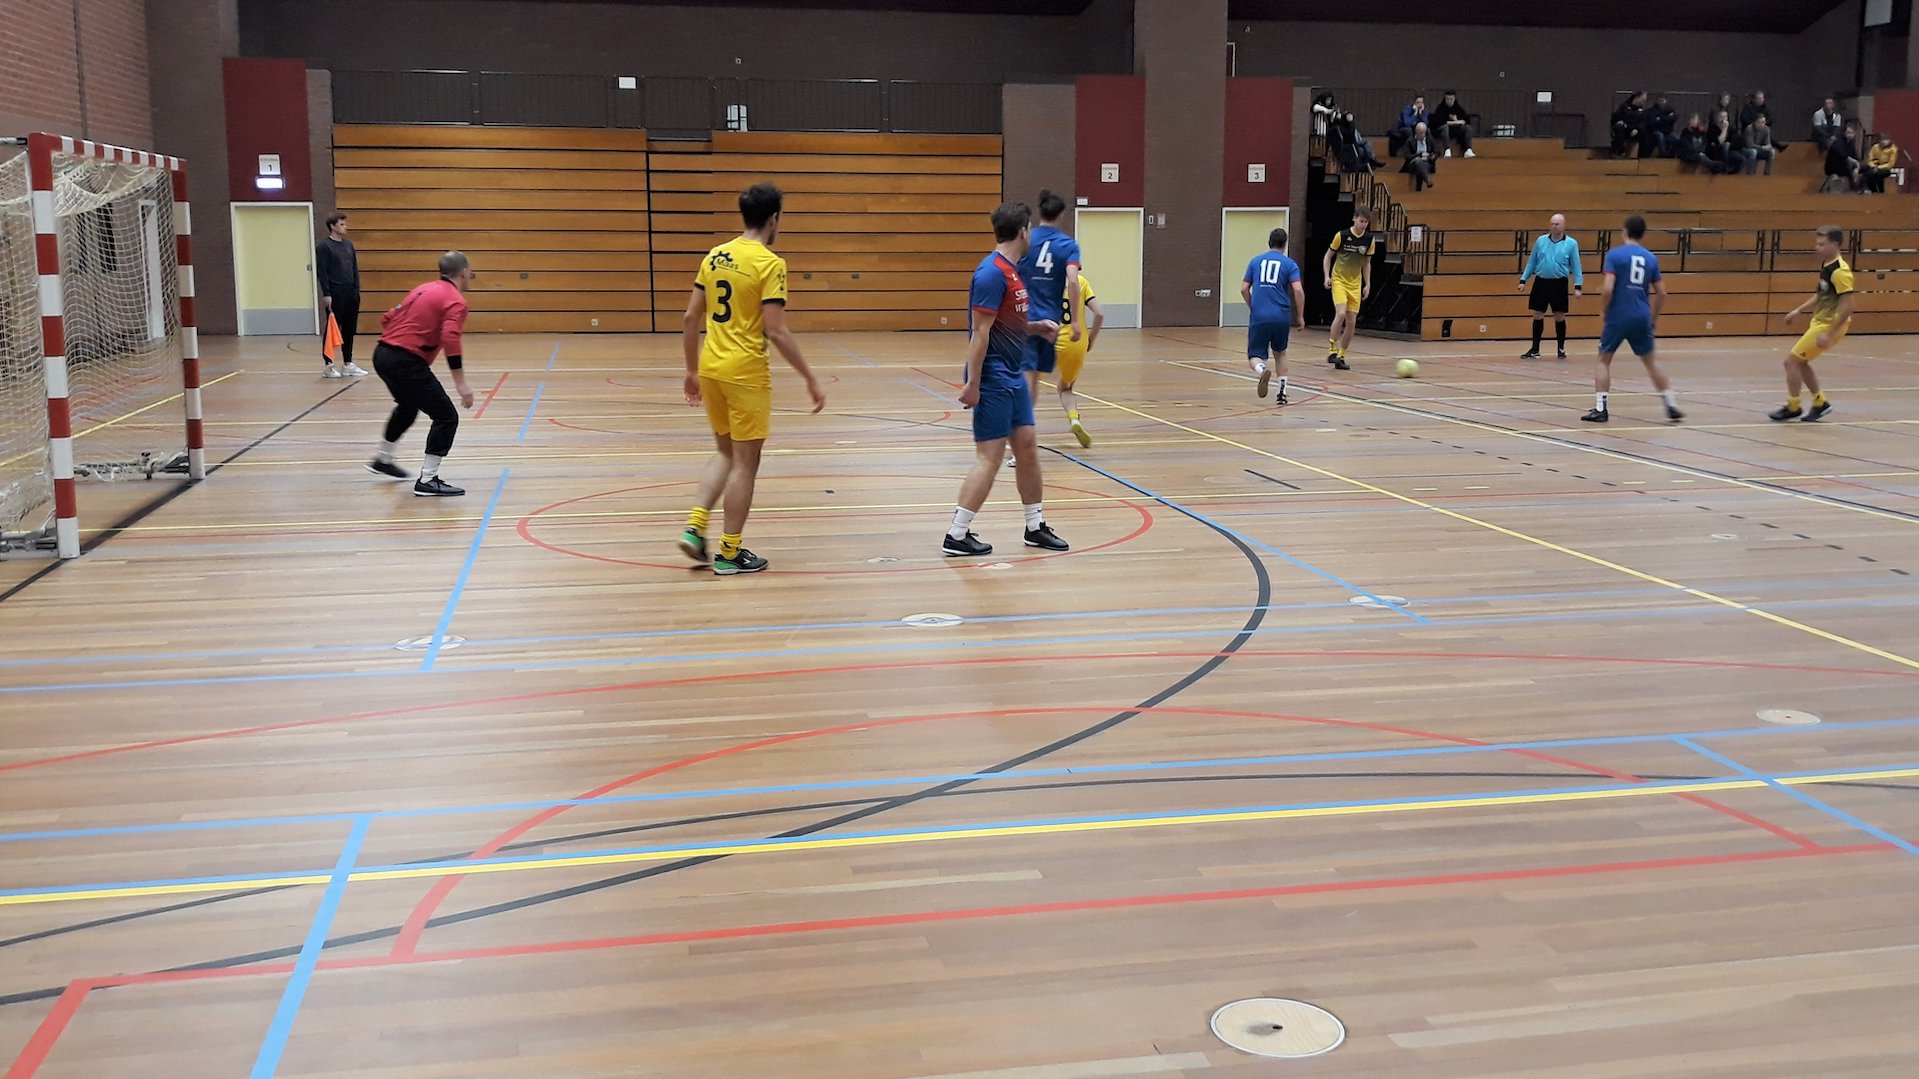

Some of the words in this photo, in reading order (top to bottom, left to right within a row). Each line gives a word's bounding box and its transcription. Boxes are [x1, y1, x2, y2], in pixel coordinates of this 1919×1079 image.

[1107, 171, 1113, 180] 2
[1254, 172, 1260, 180] 3
[1035, 240, 1054, 274] 4
[1630, 254, 1646, 285] 6
[1260, 259, 1281, 284] 10
[712, 279, 732, 323] 3
[1061, 298, 1072, 324] 8
